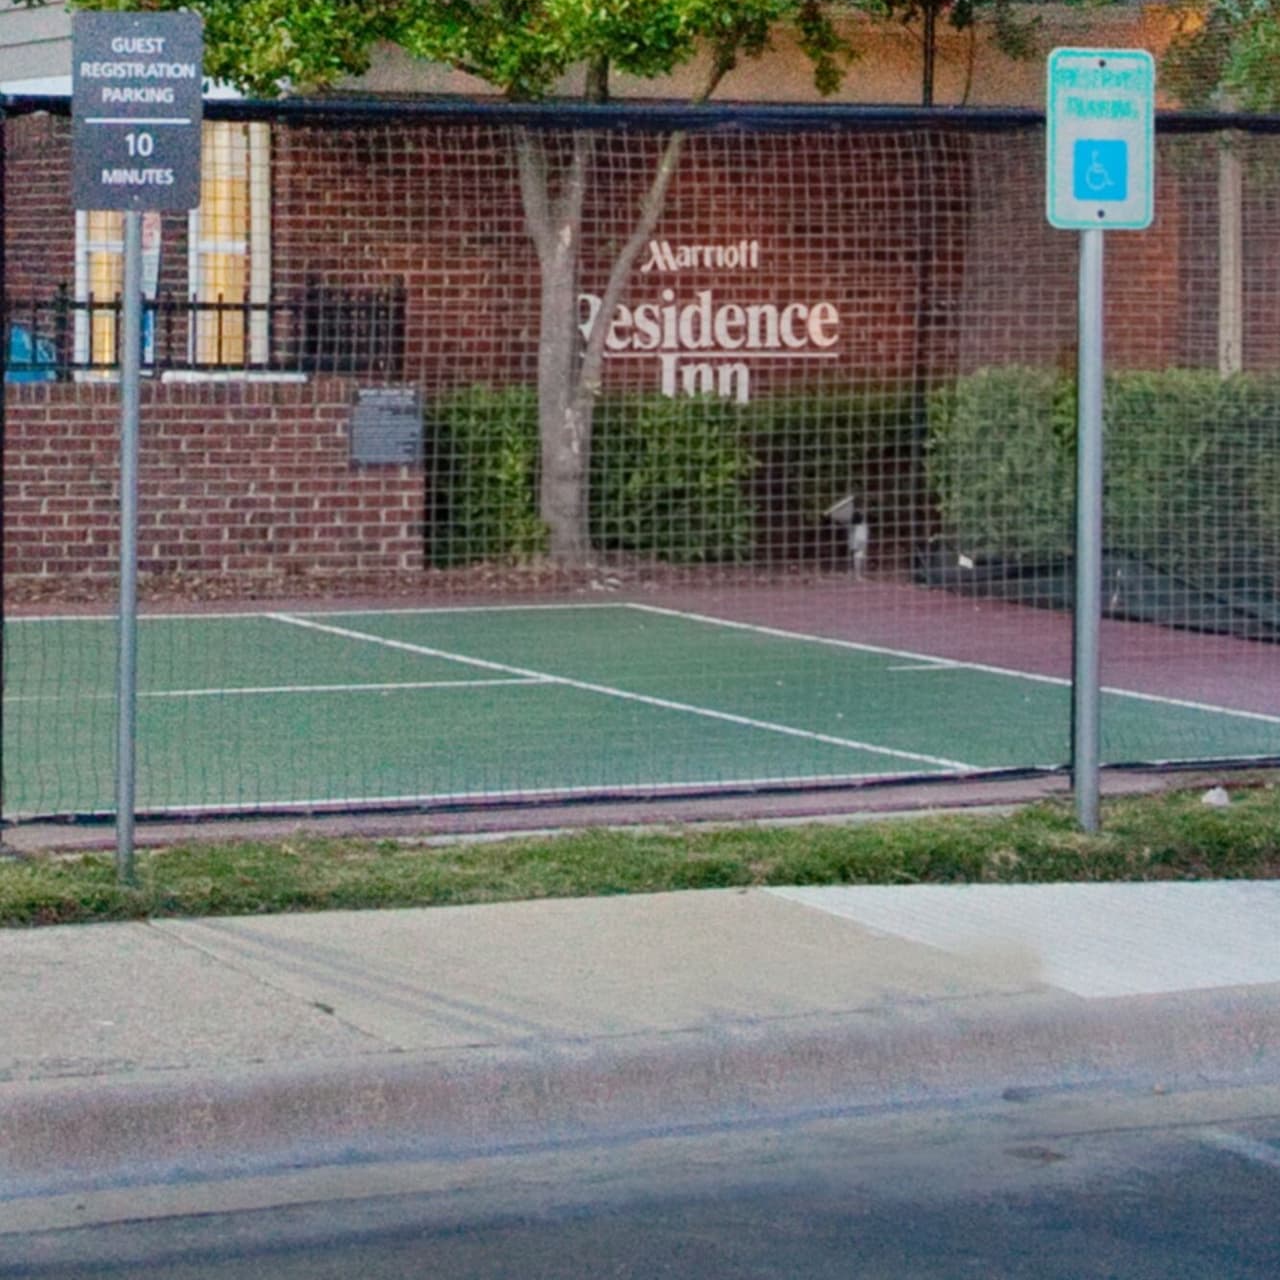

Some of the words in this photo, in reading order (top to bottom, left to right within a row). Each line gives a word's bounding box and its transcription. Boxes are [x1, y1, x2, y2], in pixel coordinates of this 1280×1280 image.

[112, 37, 165, 53] GUEST
[80, 62, 195, 78] REGISTRATION
[102, 88, 174, 103] PARKING
[125, 133, 153, 156] 10
[102, 168, 174, 184] MINUTES
[640, 240, 759, 271] Marriott
[660, 354, 749, 403] Inn
